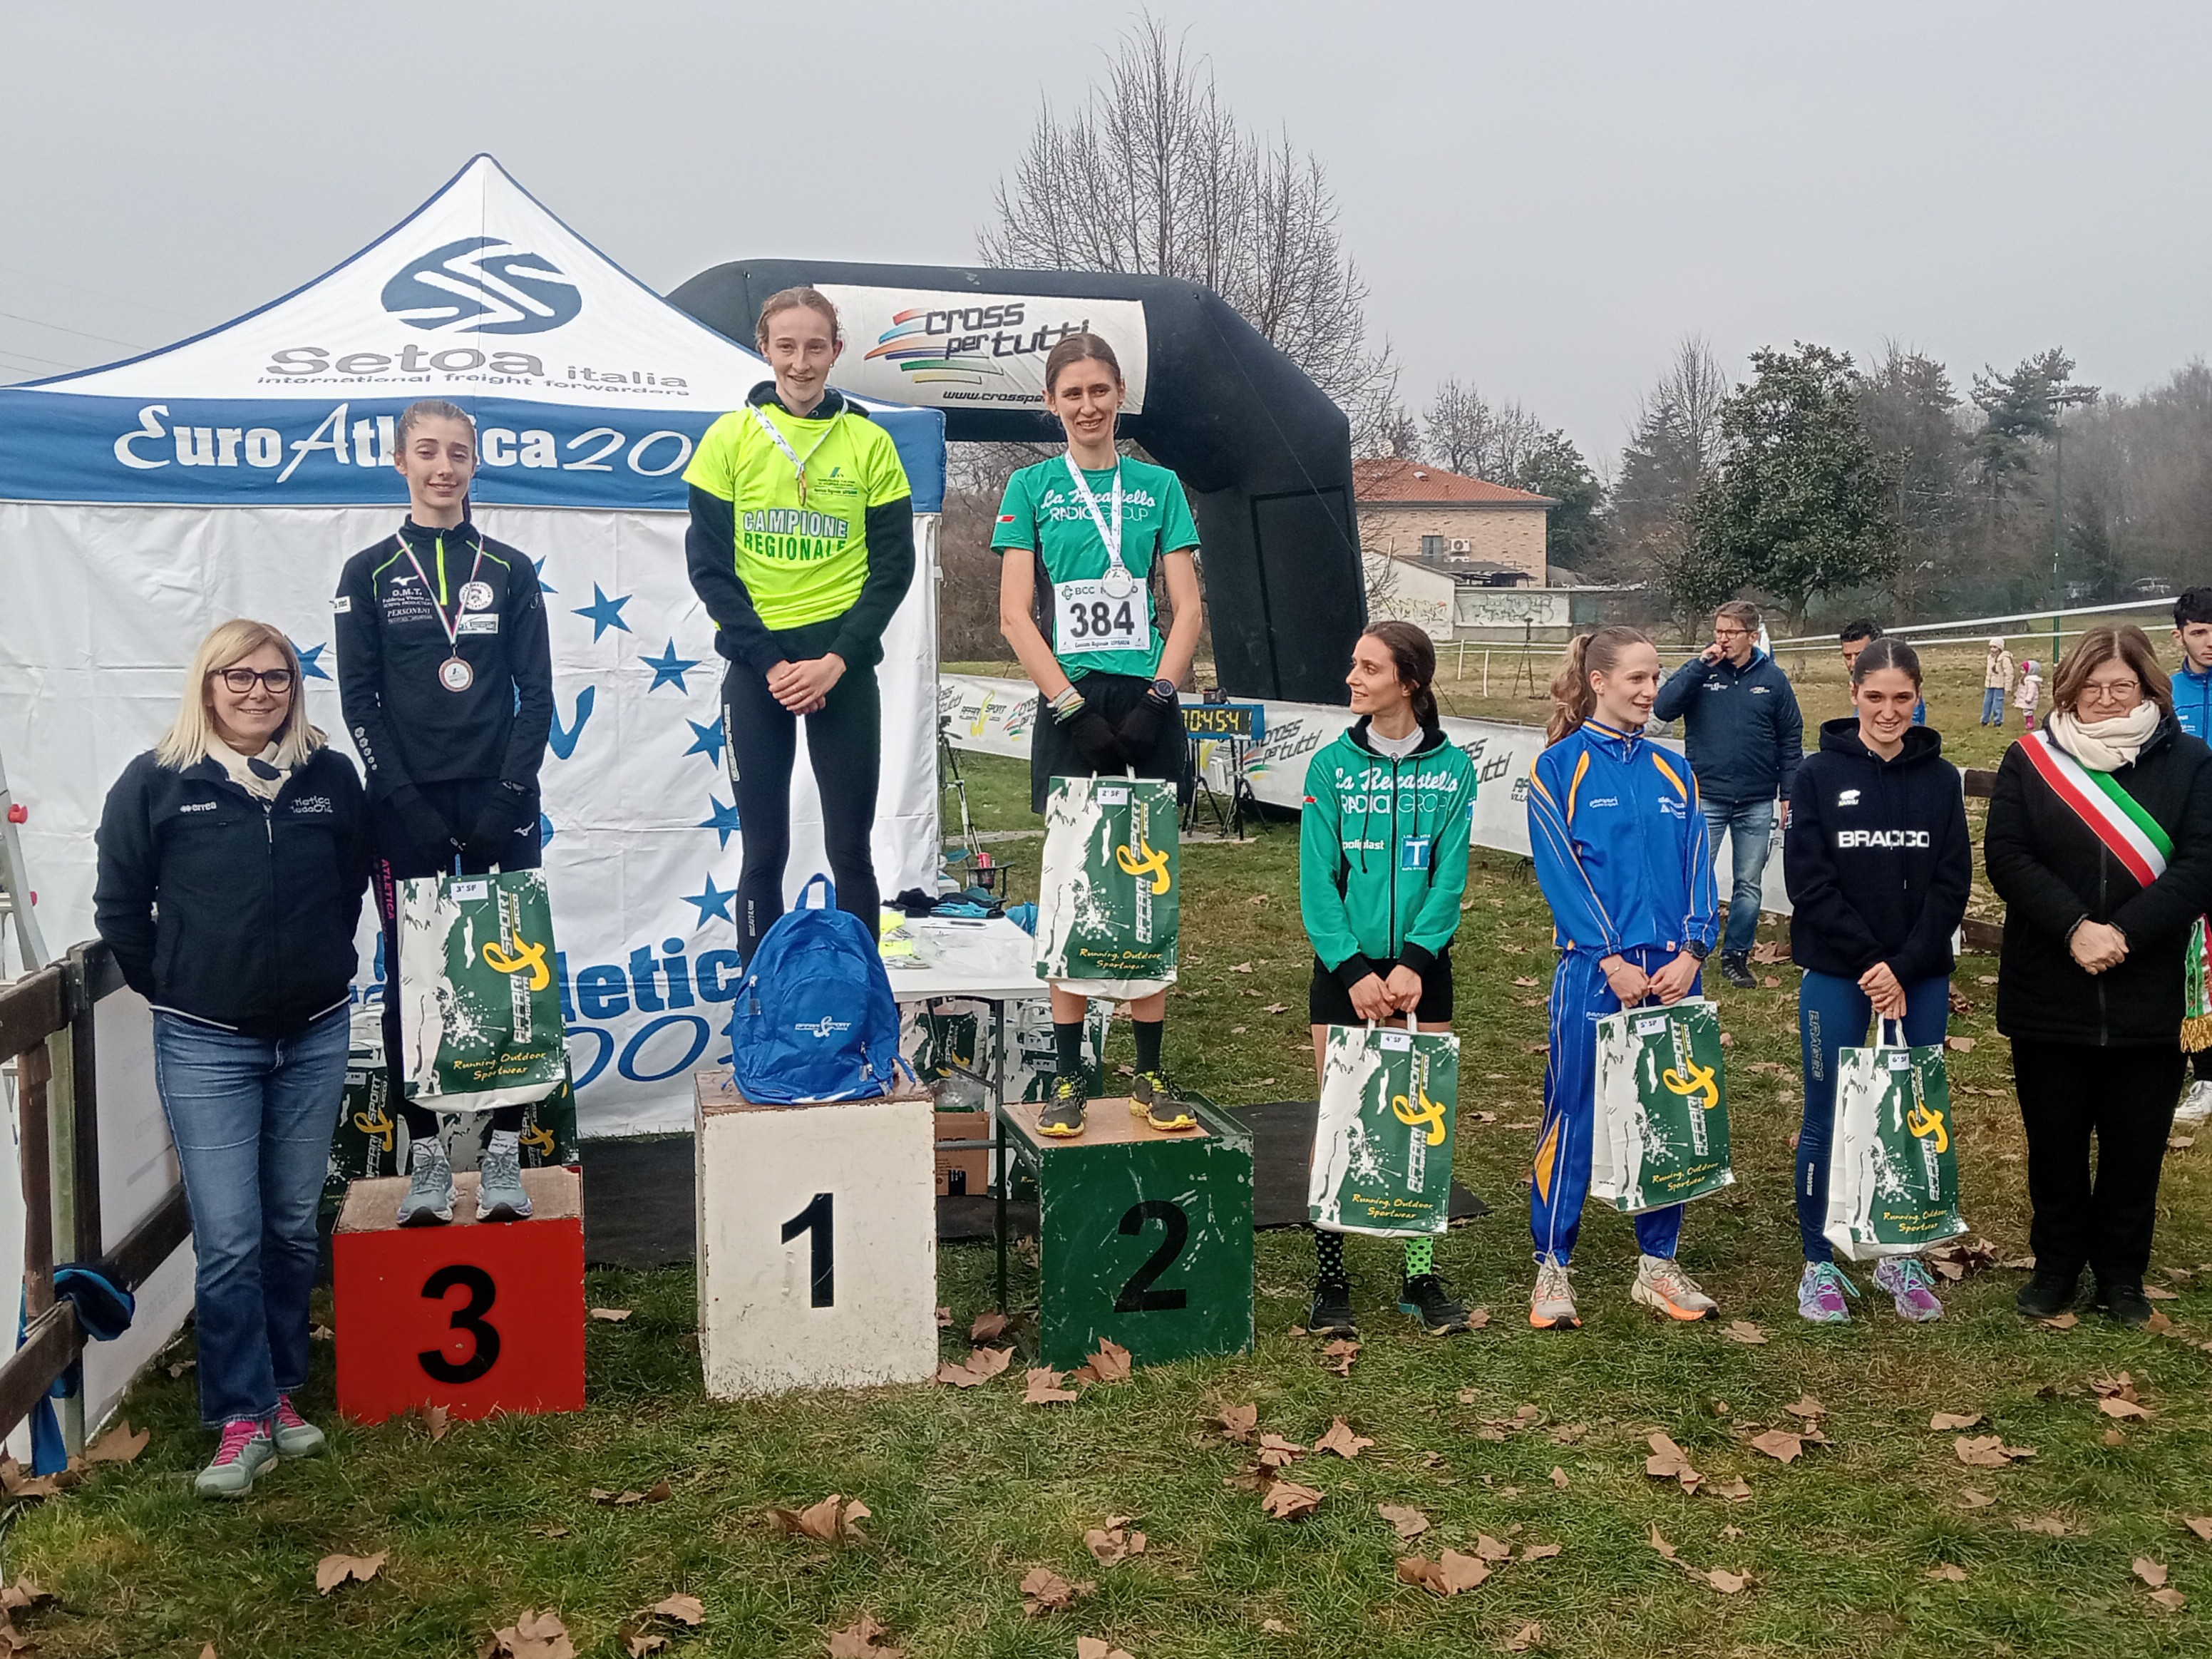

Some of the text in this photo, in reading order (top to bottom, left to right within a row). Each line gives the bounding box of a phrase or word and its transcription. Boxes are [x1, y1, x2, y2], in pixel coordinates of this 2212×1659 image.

[926, 303, 1025, 335] cross
[945, 333, 989, 360] per
[266, 344, 687, 388] Setoa italia
[257, 374, 689, 396] international freight forwarders
[1041, 489, 1065, 508] La
[743, 508, 850, 539] CAMPIONE
[744, 533, 847, 560] REGIONALE
[393, 588, 422, 597] O.M.T.
[387, 607, 431, 617] PERSONENI
[1070, 601, 1135, 637] 384
[1130, 793, 1141, 861] SPORT
[1838, 831, 1929, 848] BRACCO
[1342, 839, 1384, 851] poliplast
[381, 859, 395, 920] ATLETICA
[496, 884, 514, 957] SPORT
[1136, 876, 1147, 943] AFFARI
[1096, 960, 1146, 969] Sportwear
[1123, 950, 1163, 959] Outdoor
[509, 974, 525, 1043] AFFARI
[500, 1052, 547, 1062] Outdoor
[1670, 1017, 1689, 1080] SPORT
[473, 1066, 528, 1082] Sportwear
[1409, 1044, 1422, 1111] SPORT
[368, 1074, 381, 1123] SPORT
[1687, 1095, 1704, 1156] AFFARI
[1407, 1126, 1421, 1193] AFFARI
[1667, 1176, 1707, 1192] Sportwear
[1367, 1206, 1416, 1218] Sportwear
[1394, 1198, 1434, 1209] Outdoor
[781, 1193, 834, 1308] 1
[1113, 1200, 1188, 1313] 2
[417, 1265, 500, 1385] 3
